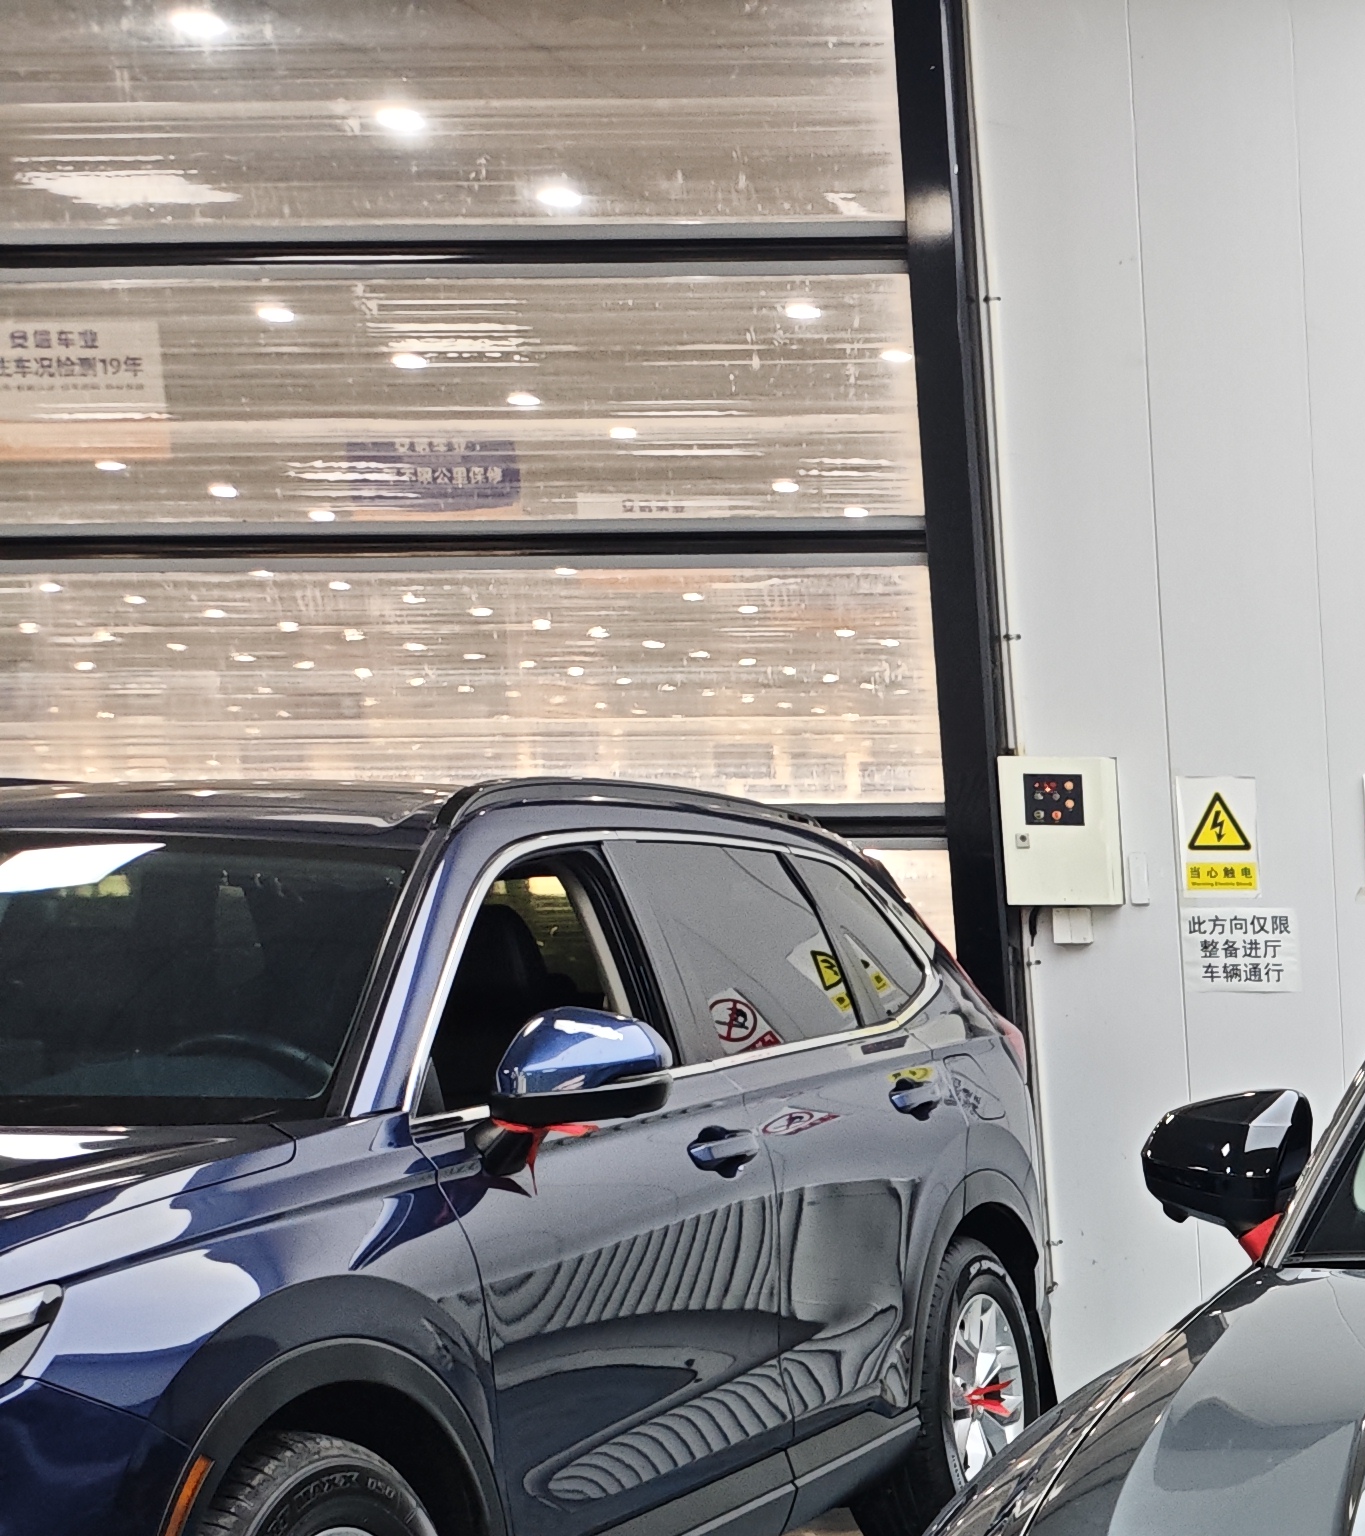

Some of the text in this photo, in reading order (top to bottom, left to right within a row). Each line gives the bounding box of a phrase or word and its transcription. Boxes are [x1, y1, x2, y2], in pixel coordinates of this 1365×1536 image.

[1190, 867, 1253, 879] 当心触电
[1188, 915, 1291, 935] 此方向仅限
[1200, 939, 1282, 959] 整备进厅
[1202, 963, 1284, 983] 车辆通行
